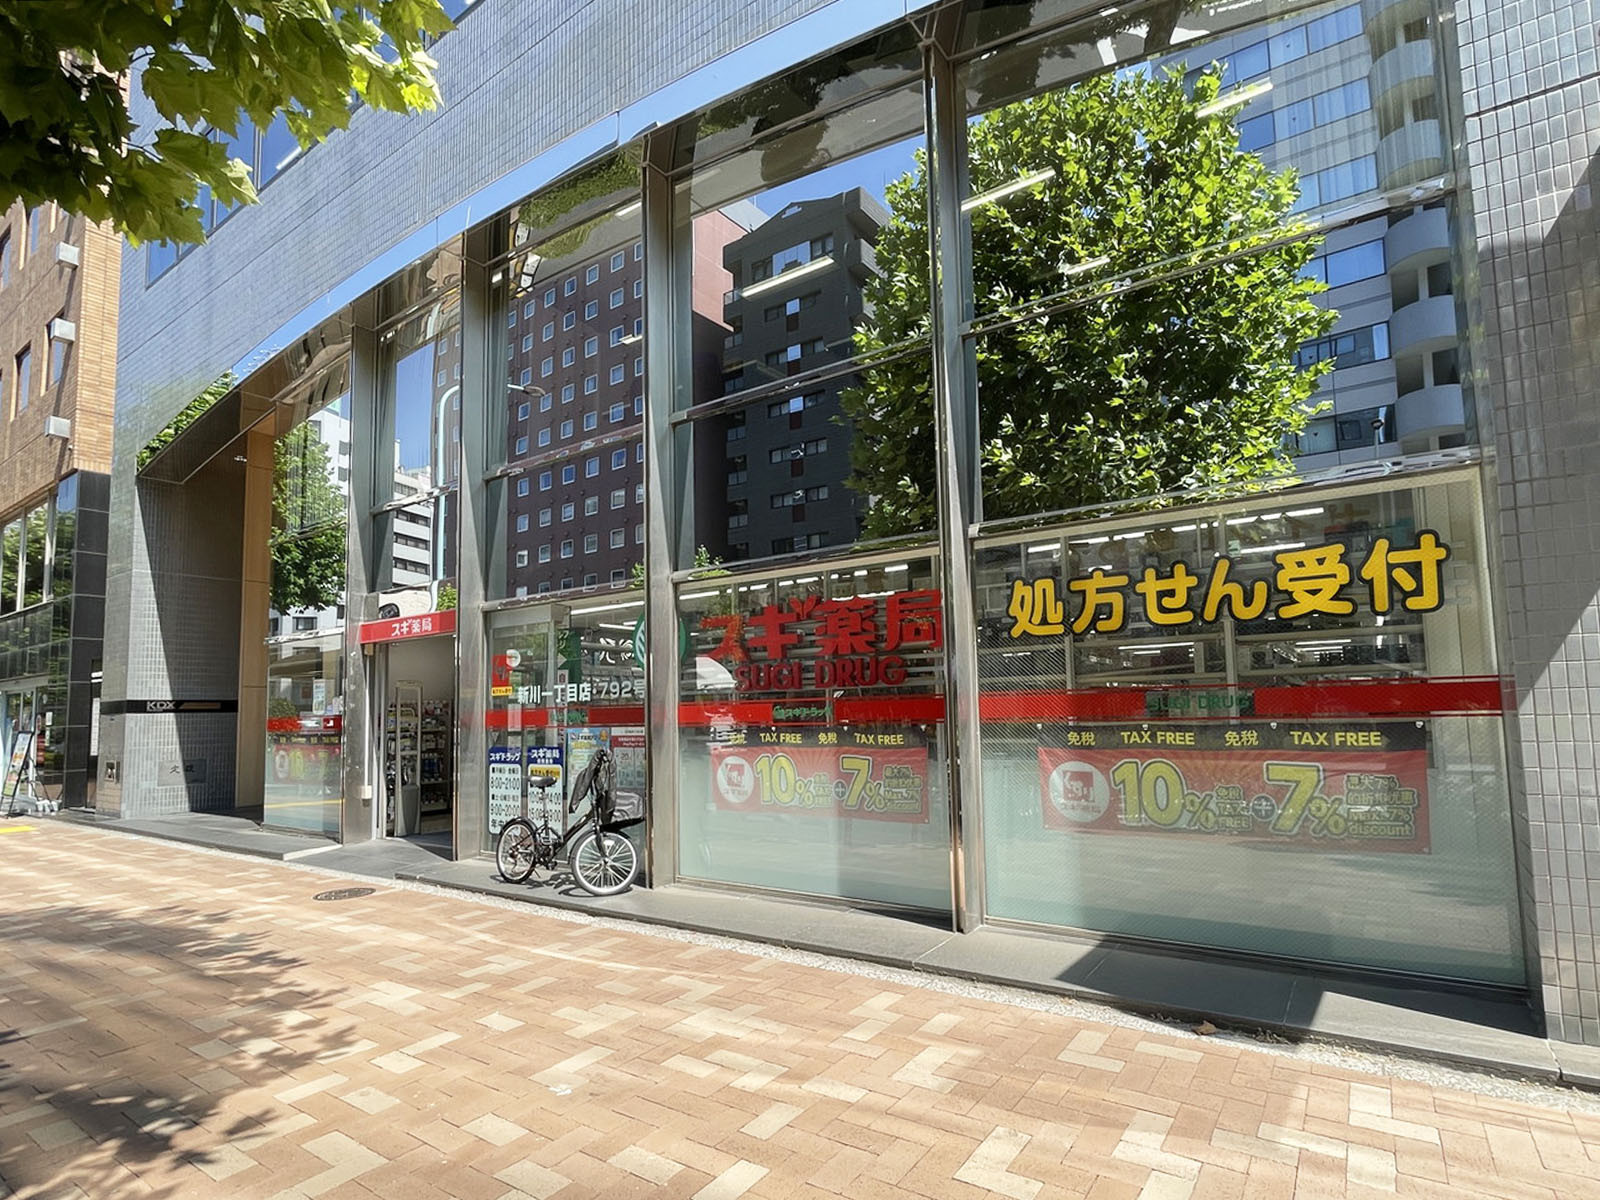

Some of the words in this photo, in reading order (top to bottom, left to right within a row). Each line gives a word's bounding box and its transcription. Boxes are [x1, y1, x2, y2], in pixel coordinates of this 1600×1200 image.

[1007, 529, 1451, 639] 処方せん受付
[391, 617, 433, 637] スギ薬局
[699, 589, 943, 661] スギ薬局
[734, 660, 803, 692] SUGI
[814, 656, 908, 689] DRUG
[517, 682, 592, 705] 新川一丁目店
[146, 701, 176, 711] KDX
[760, 733, 778, 743] TAX
[780, 733, 802, 744] FREE
[854, 732, 875, 744] TAX
[877, 733, 904, 745] FREE
[1121, 731, 1152, 744] TAX
[1156, 732, 1195, 745] FREE
[1289, 731, 1330, 746] TAX
[1334, 731, 1383, 747] FREE
[755, 753, 813, 807] 10%
[841, 755, 887, 810] 7%
[1110, 759, 1216, 831] 10%
[1265, 762, 1347, 837] 7%
